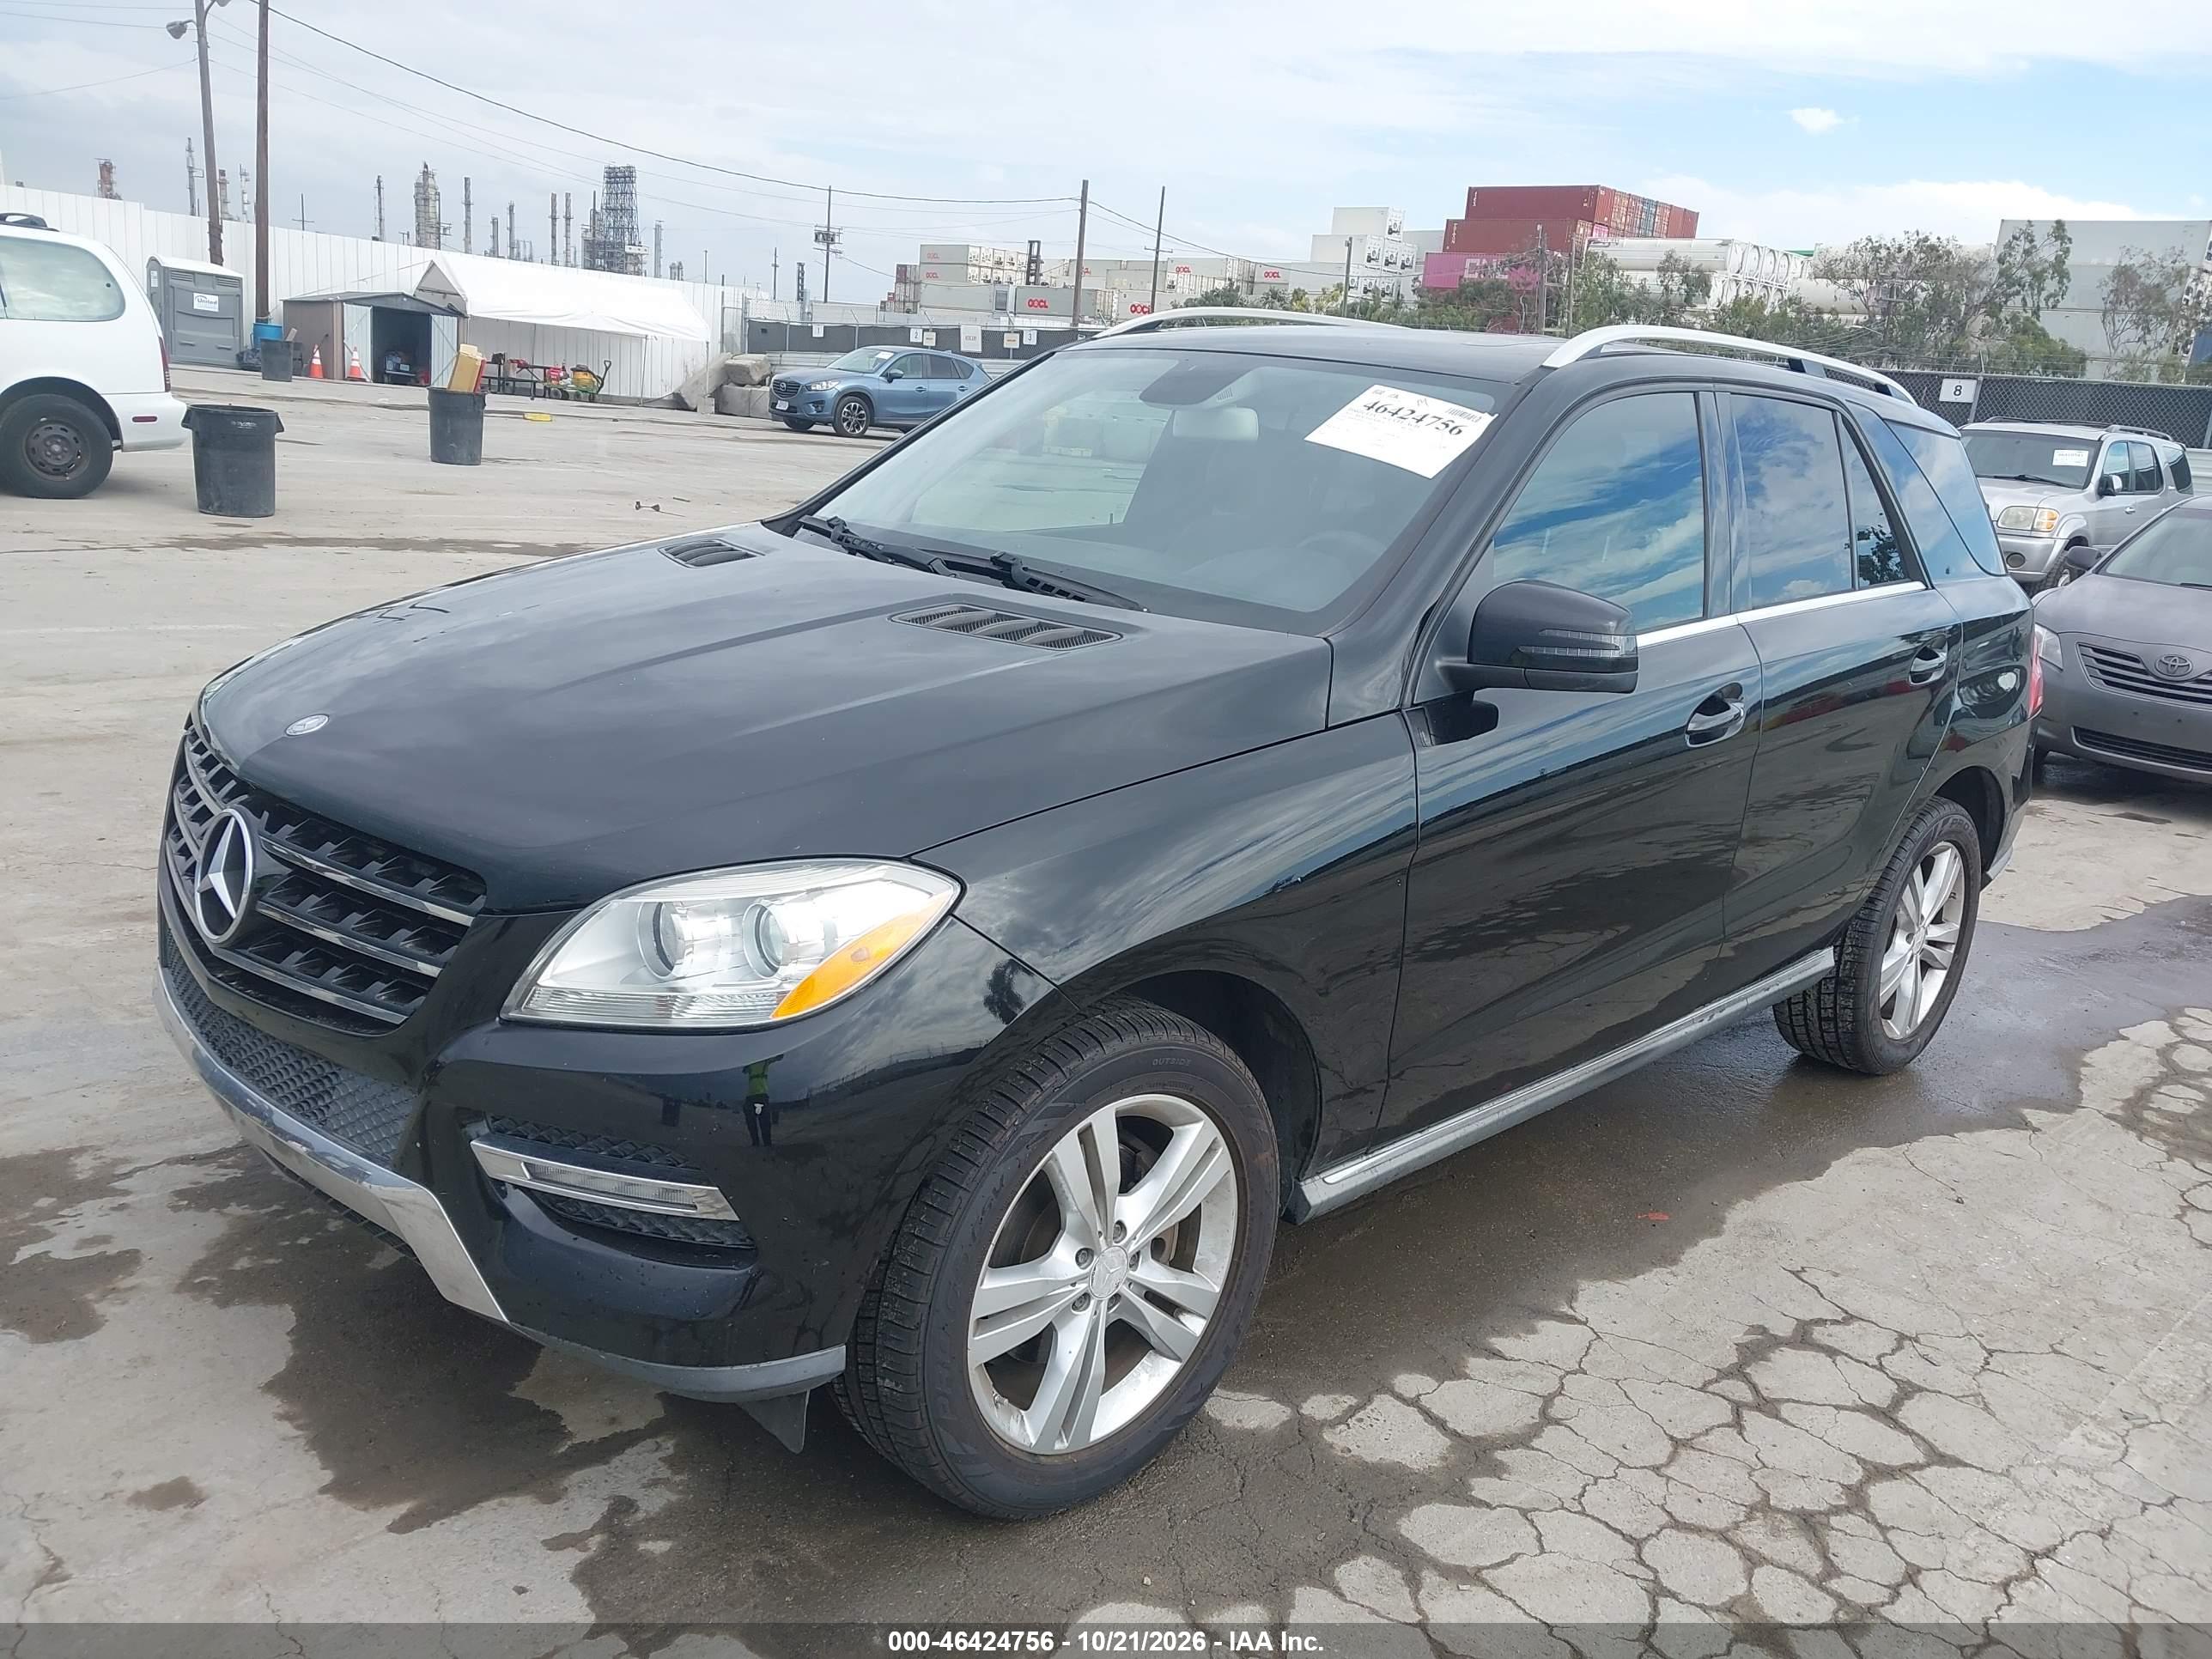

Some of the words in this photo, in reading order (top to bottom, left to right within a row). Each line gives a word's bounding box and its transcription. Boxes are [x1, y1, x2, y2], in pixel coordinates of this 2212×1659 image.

[1263, 270, 1281, 279] OOCL
[1027, 298, 1048, 309] OOCL
[1954, 385, 1963, 396] 8
[1362, 400, 1468, 436] 46424756
[1152, 1057, 1192, 1066] OUTSIDE
